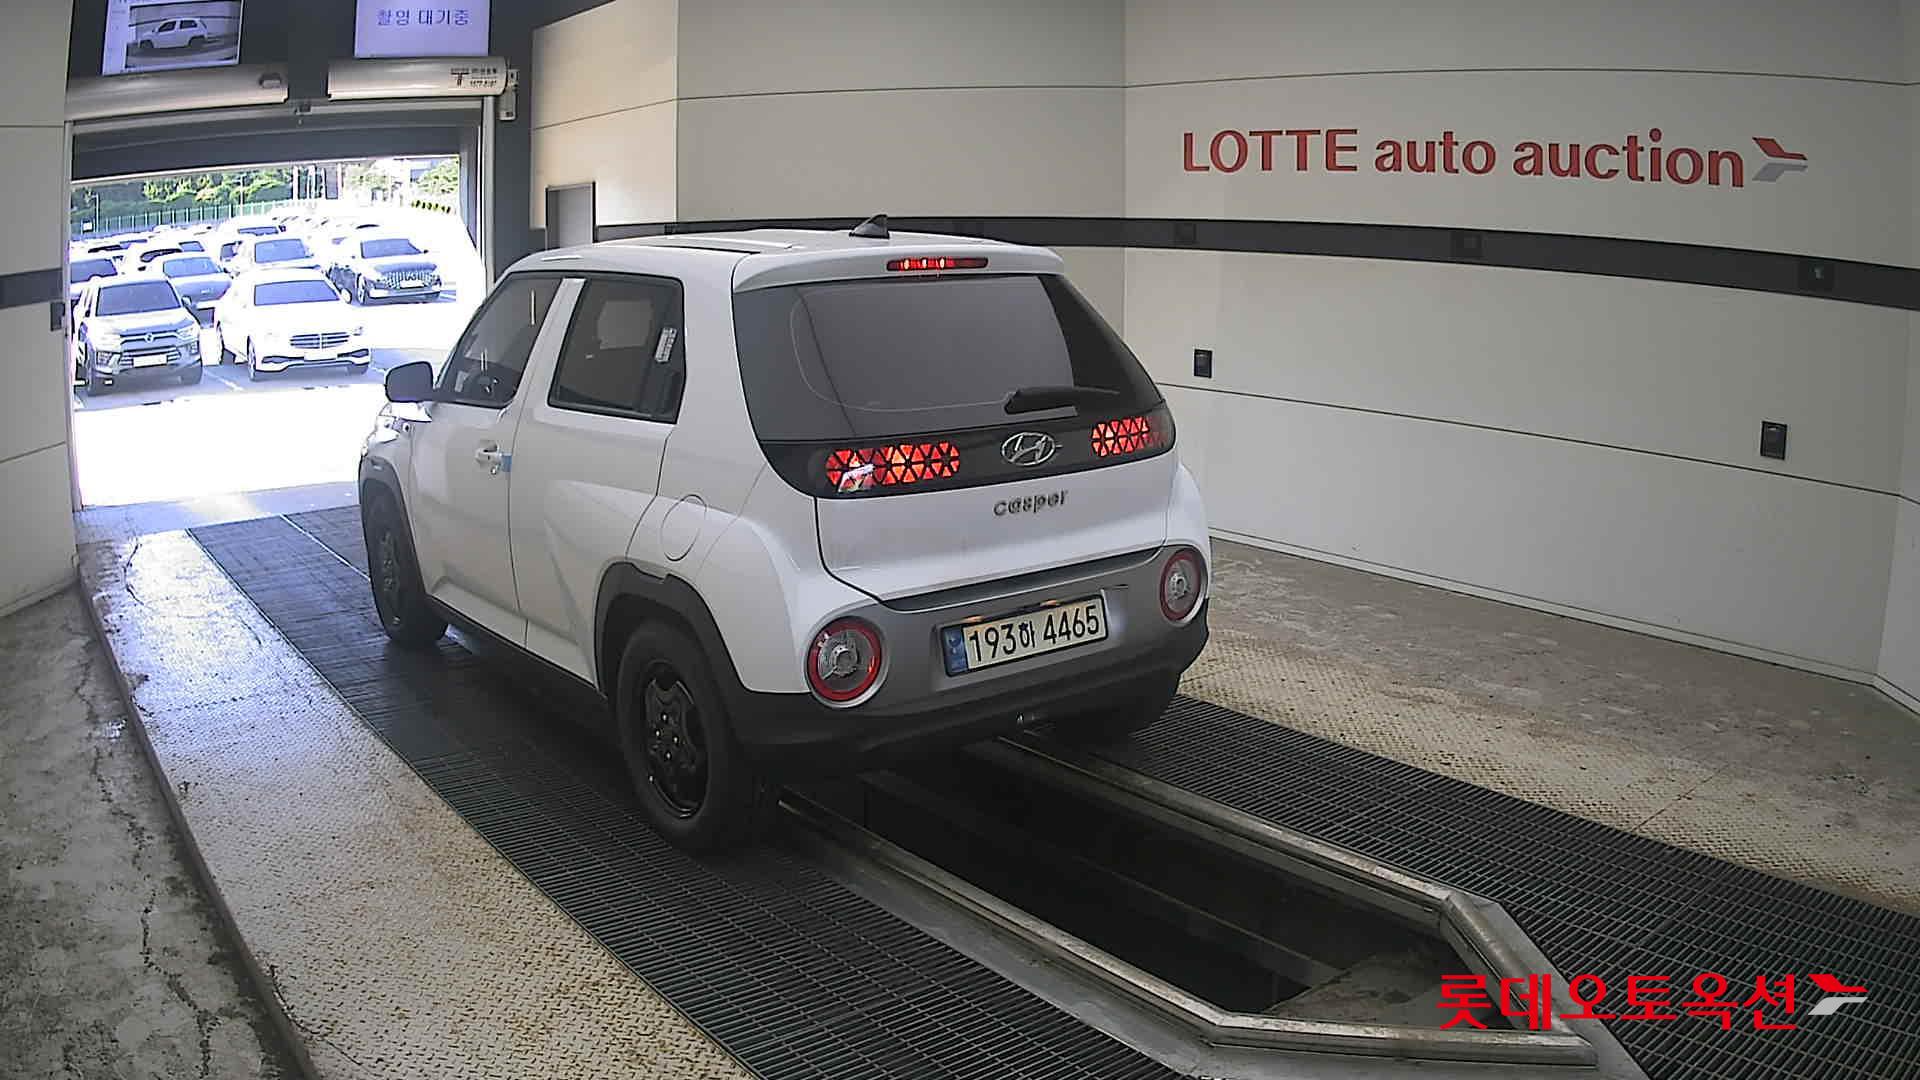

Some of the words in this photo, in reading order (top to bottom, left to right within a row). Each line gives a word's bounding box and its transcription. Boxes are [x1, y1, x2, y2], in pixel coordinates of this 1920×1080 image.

[418, 9, 469, 26] 대기중
[1184, 129, 1358, 172] LOTTE
[1374, 131, 1496, 174] auto
[1513, 128, 1744, 188] auction
[993, 490, 1069, 516] casper
[969, 620, 1036, 662] 193하
[1043, 605, 1100, 644] 4465
